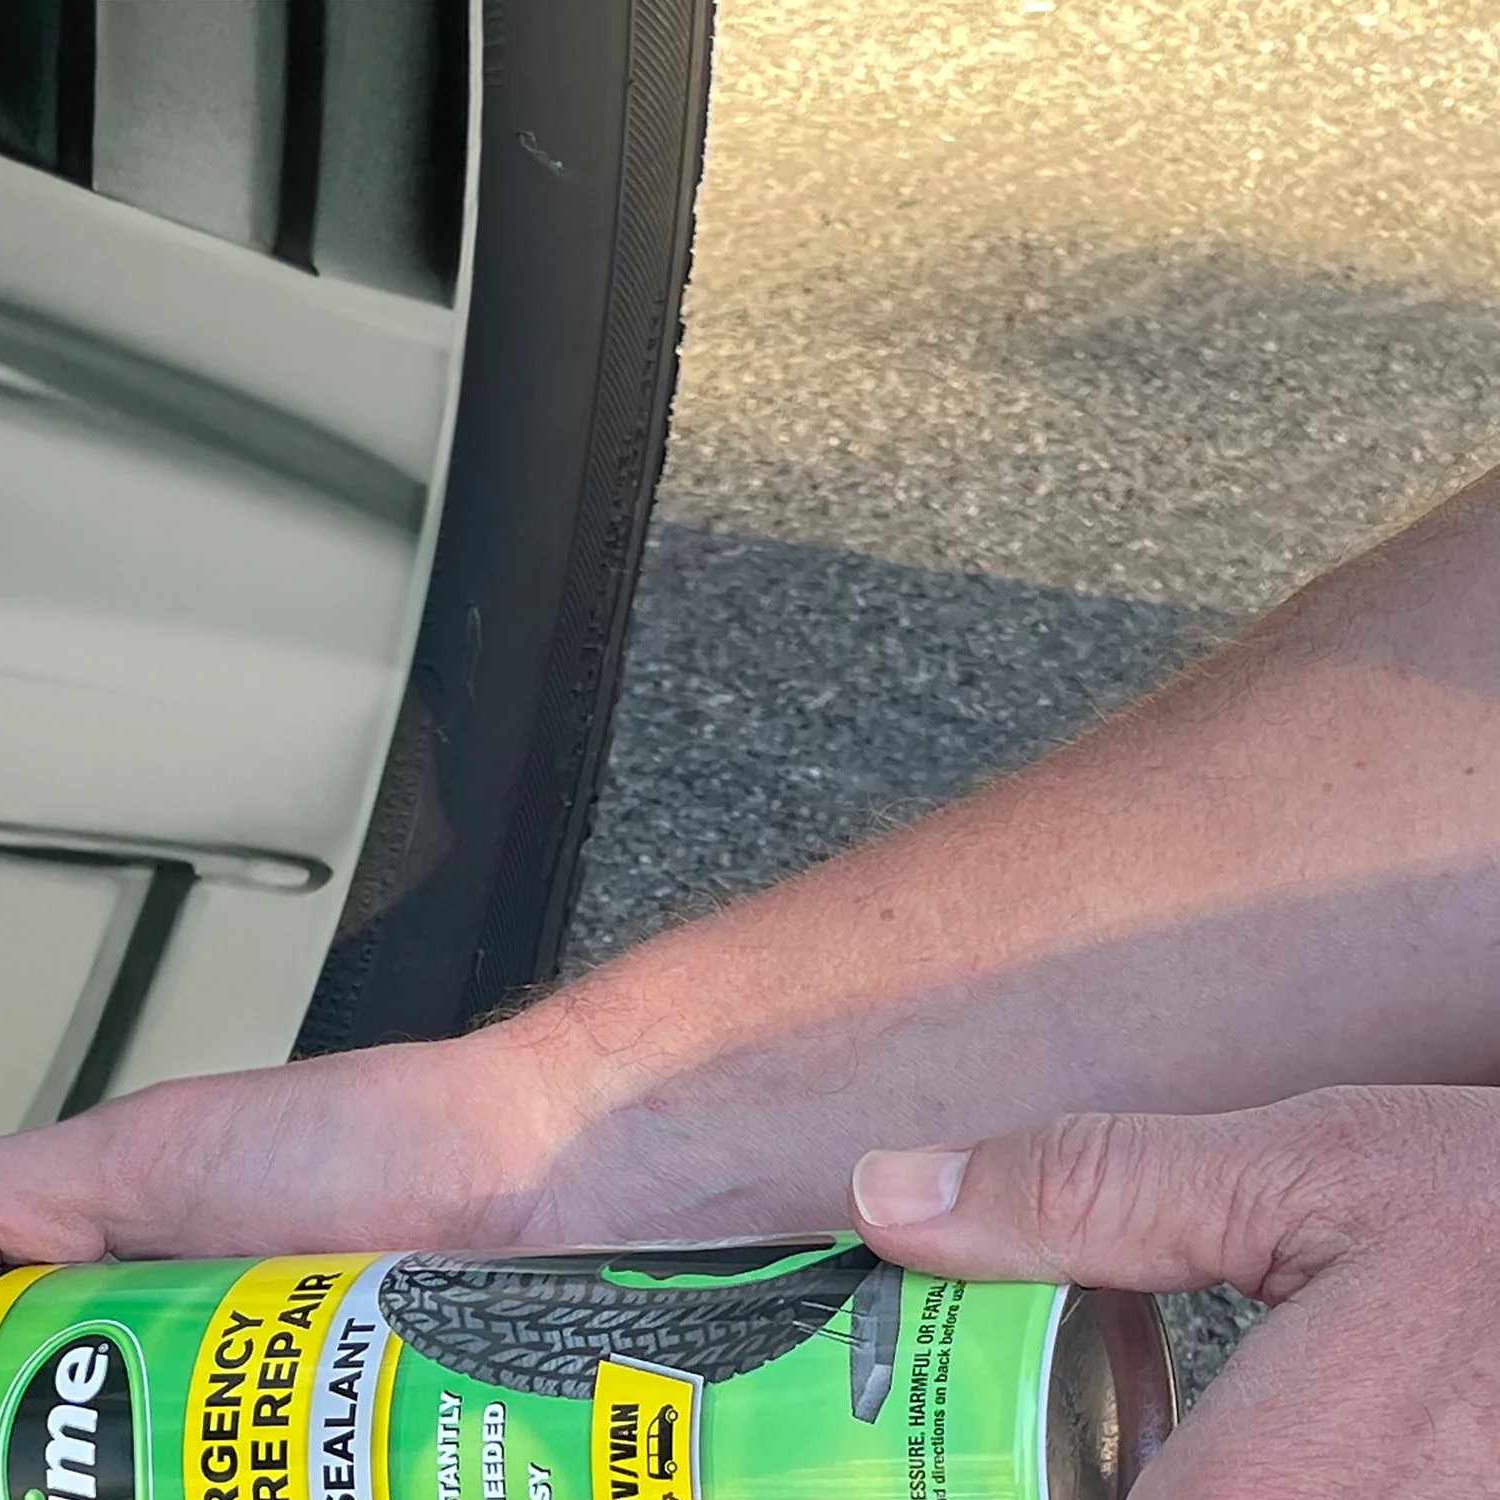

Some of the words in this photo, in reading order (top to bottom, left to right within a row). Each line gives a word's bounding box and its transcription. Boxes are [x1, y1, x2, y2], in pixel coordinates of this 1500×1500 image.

[922, 1282, 947, 1321] FATAL
[917, 1318, 935, 1345] OR
[939, 1304, 960, 1345] before
[251, 1271, 343, 1427] REPAIR
[934, 1348, 951, 1384] back
[909, 1349, 932, 1427] HARMFUL
[934, 1387, 947, 1405] on
[931, 1409, 946, 1484] directions
